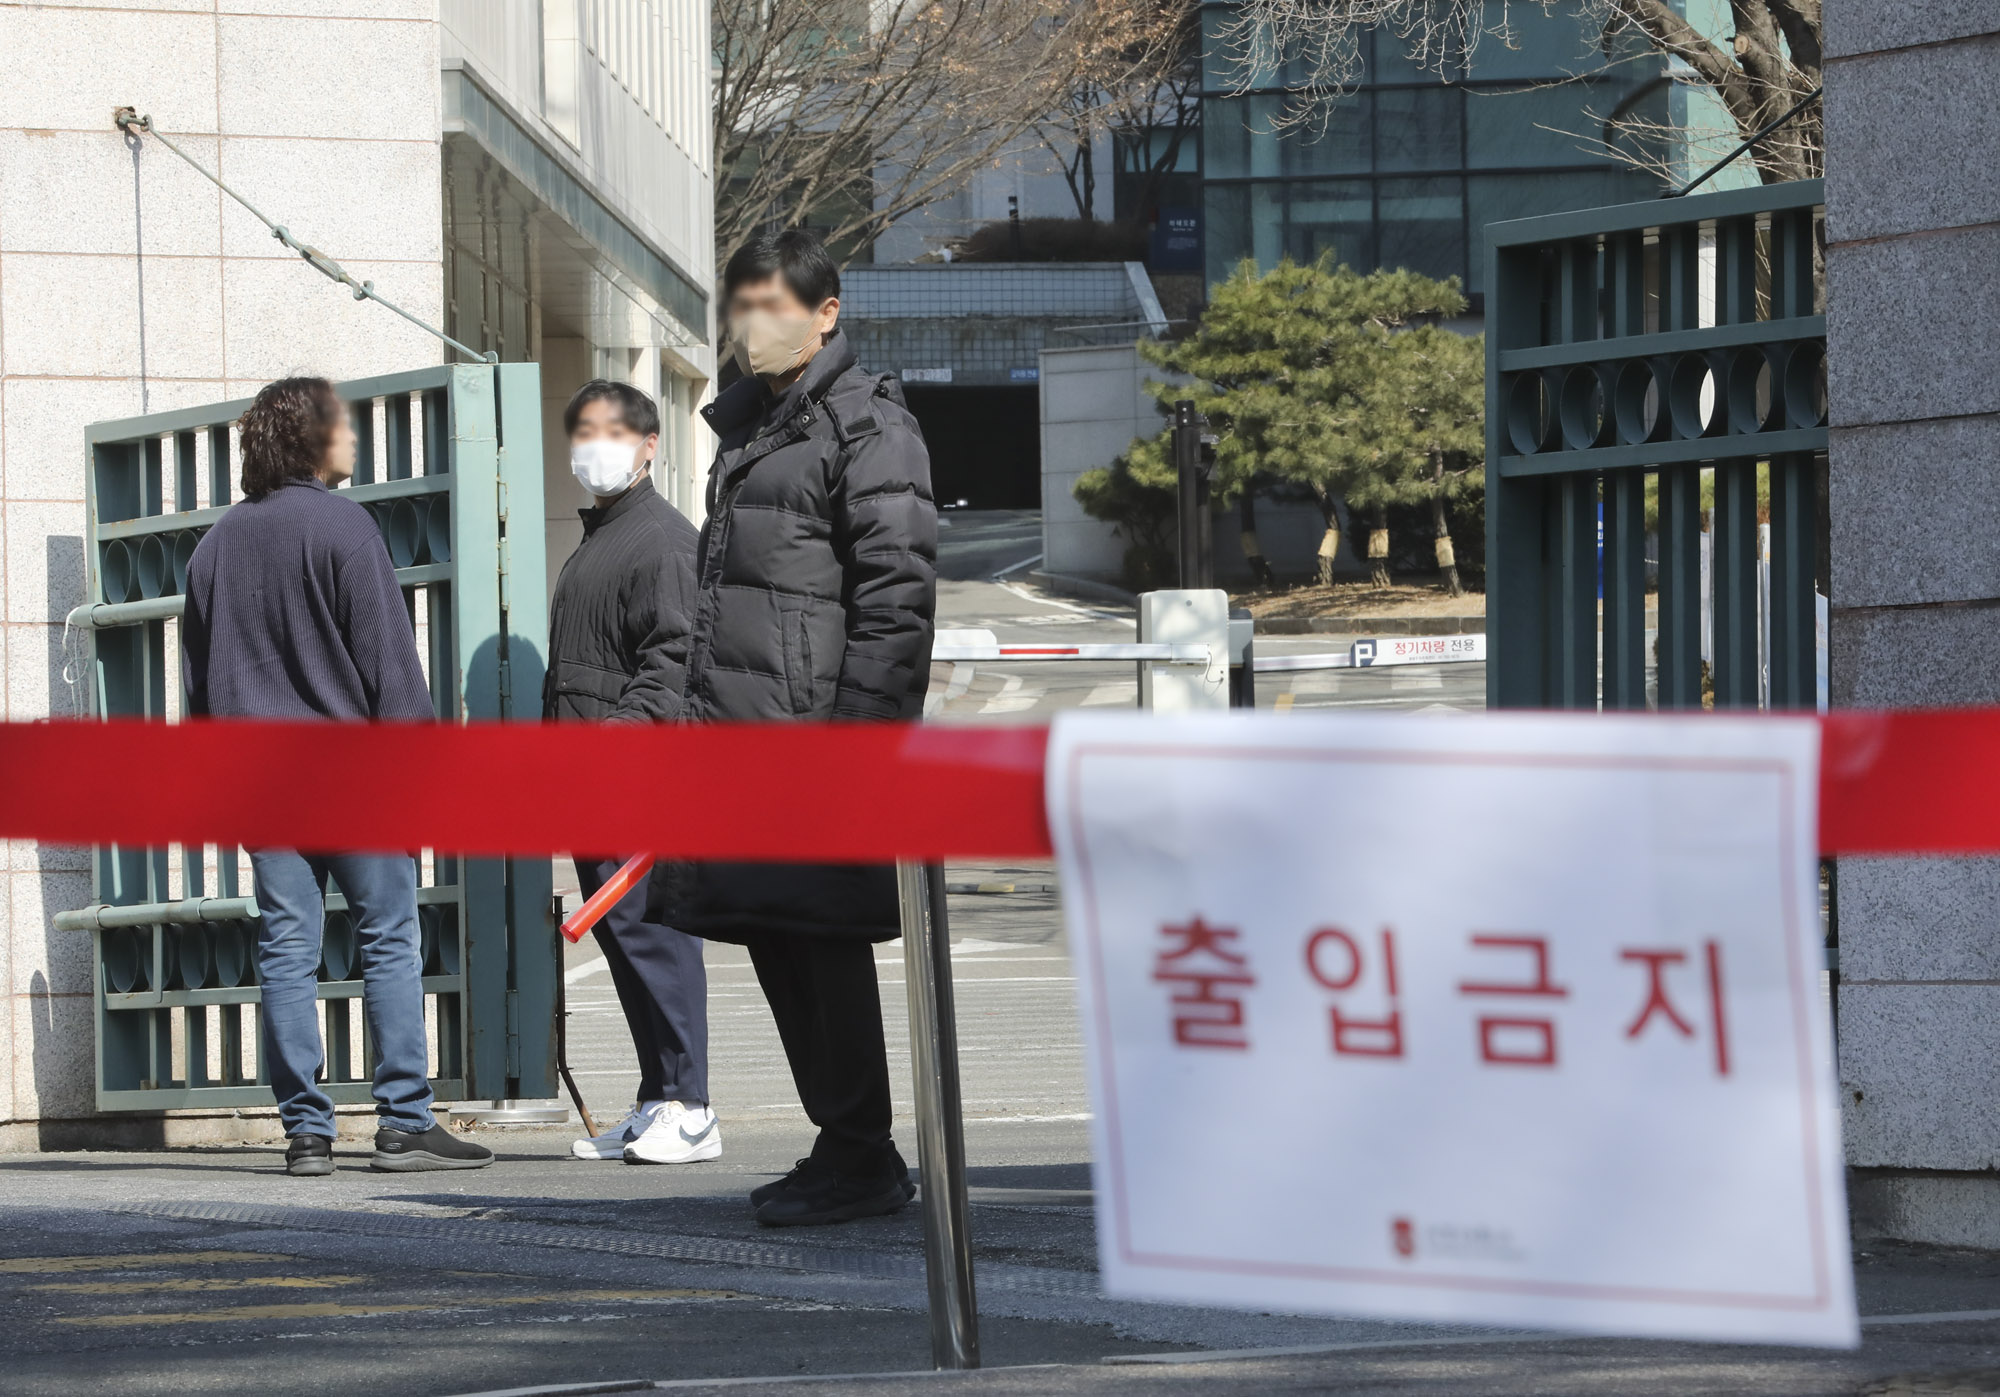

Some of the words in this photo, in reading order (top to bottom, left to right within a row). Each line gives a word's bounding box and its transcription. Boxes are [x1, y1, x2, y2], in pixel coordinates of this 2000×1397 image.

[1355, 643, 1373, 667] P
[1394, 640, 1446, 655] 정기차량
[1451, 639, 1475, 652] 전용
[1152, 913, 1729, 1077] 출입금지
